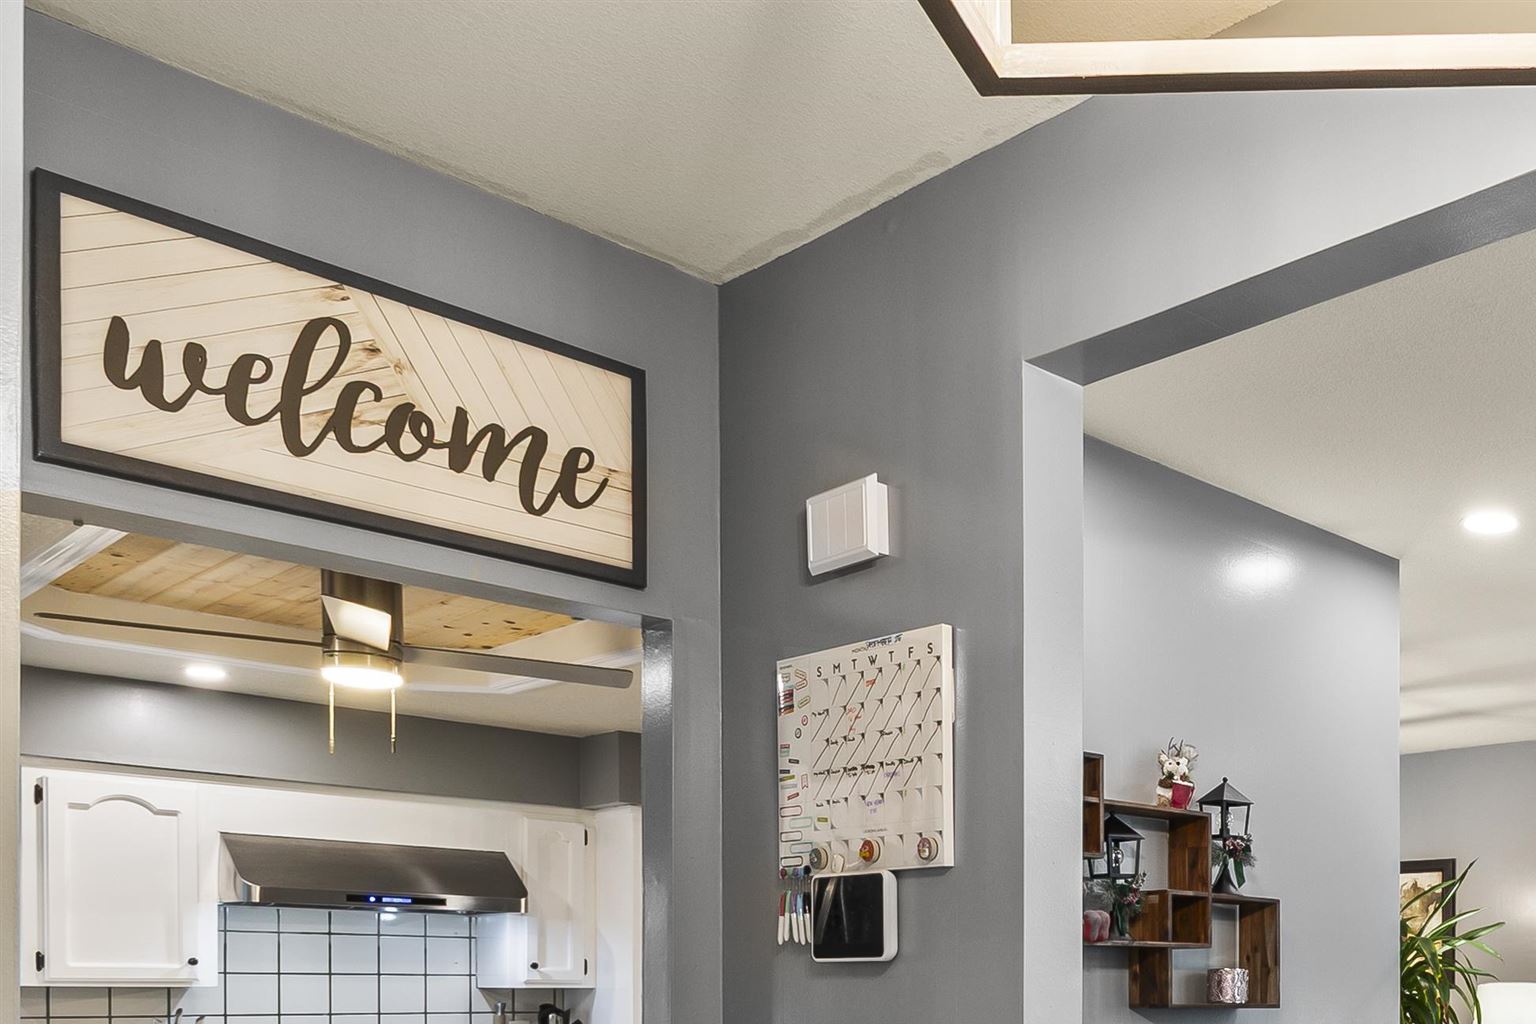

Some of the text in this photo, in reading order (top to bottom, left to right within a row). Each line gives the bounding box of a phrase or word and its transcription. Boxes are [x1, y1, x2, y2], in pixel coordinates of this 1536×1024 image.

[103, 315, 609, 516] welcome
[816, 643, 933, 678] S M T W T F S
